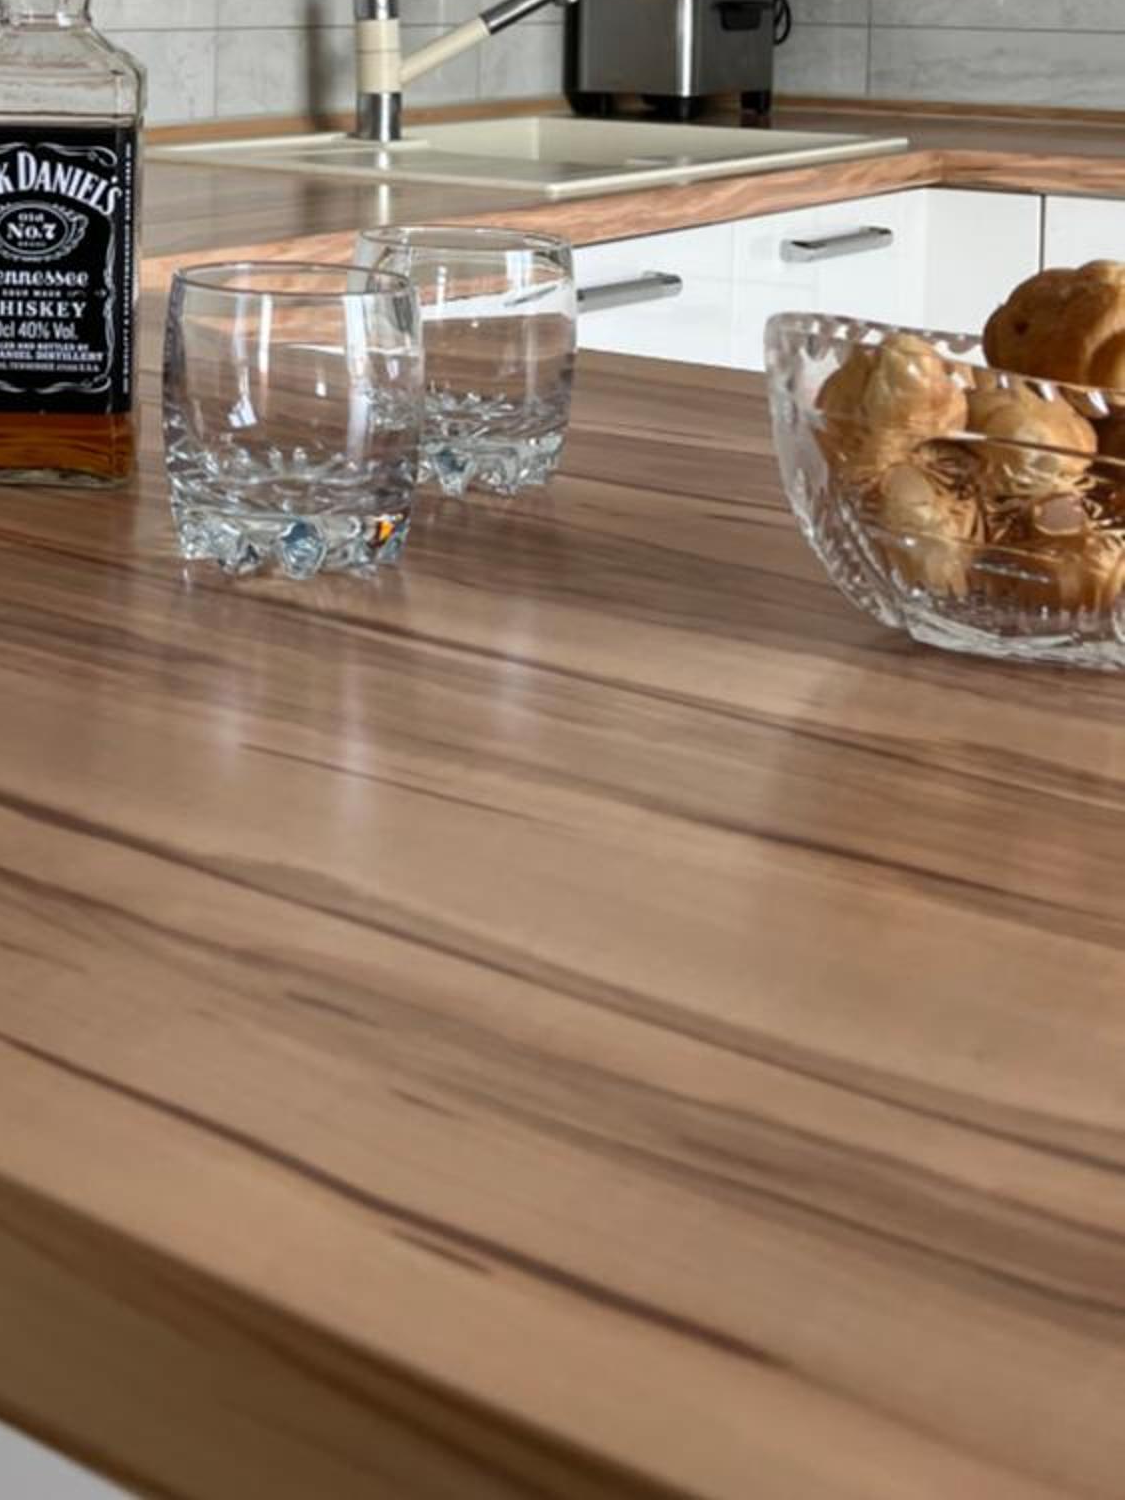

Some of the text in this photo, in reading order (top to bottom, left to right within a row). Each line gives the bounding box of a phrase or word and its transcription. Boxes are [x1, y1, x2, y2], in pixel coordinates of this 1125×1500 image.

[16, 151, 123, 216] DANIEL'S
[18, 212, 44, 222] Old
[6, 222, 58, 240] No.7
[18, 320, 50, 339] 40%
[52, 321, 78, 340] Vol.
